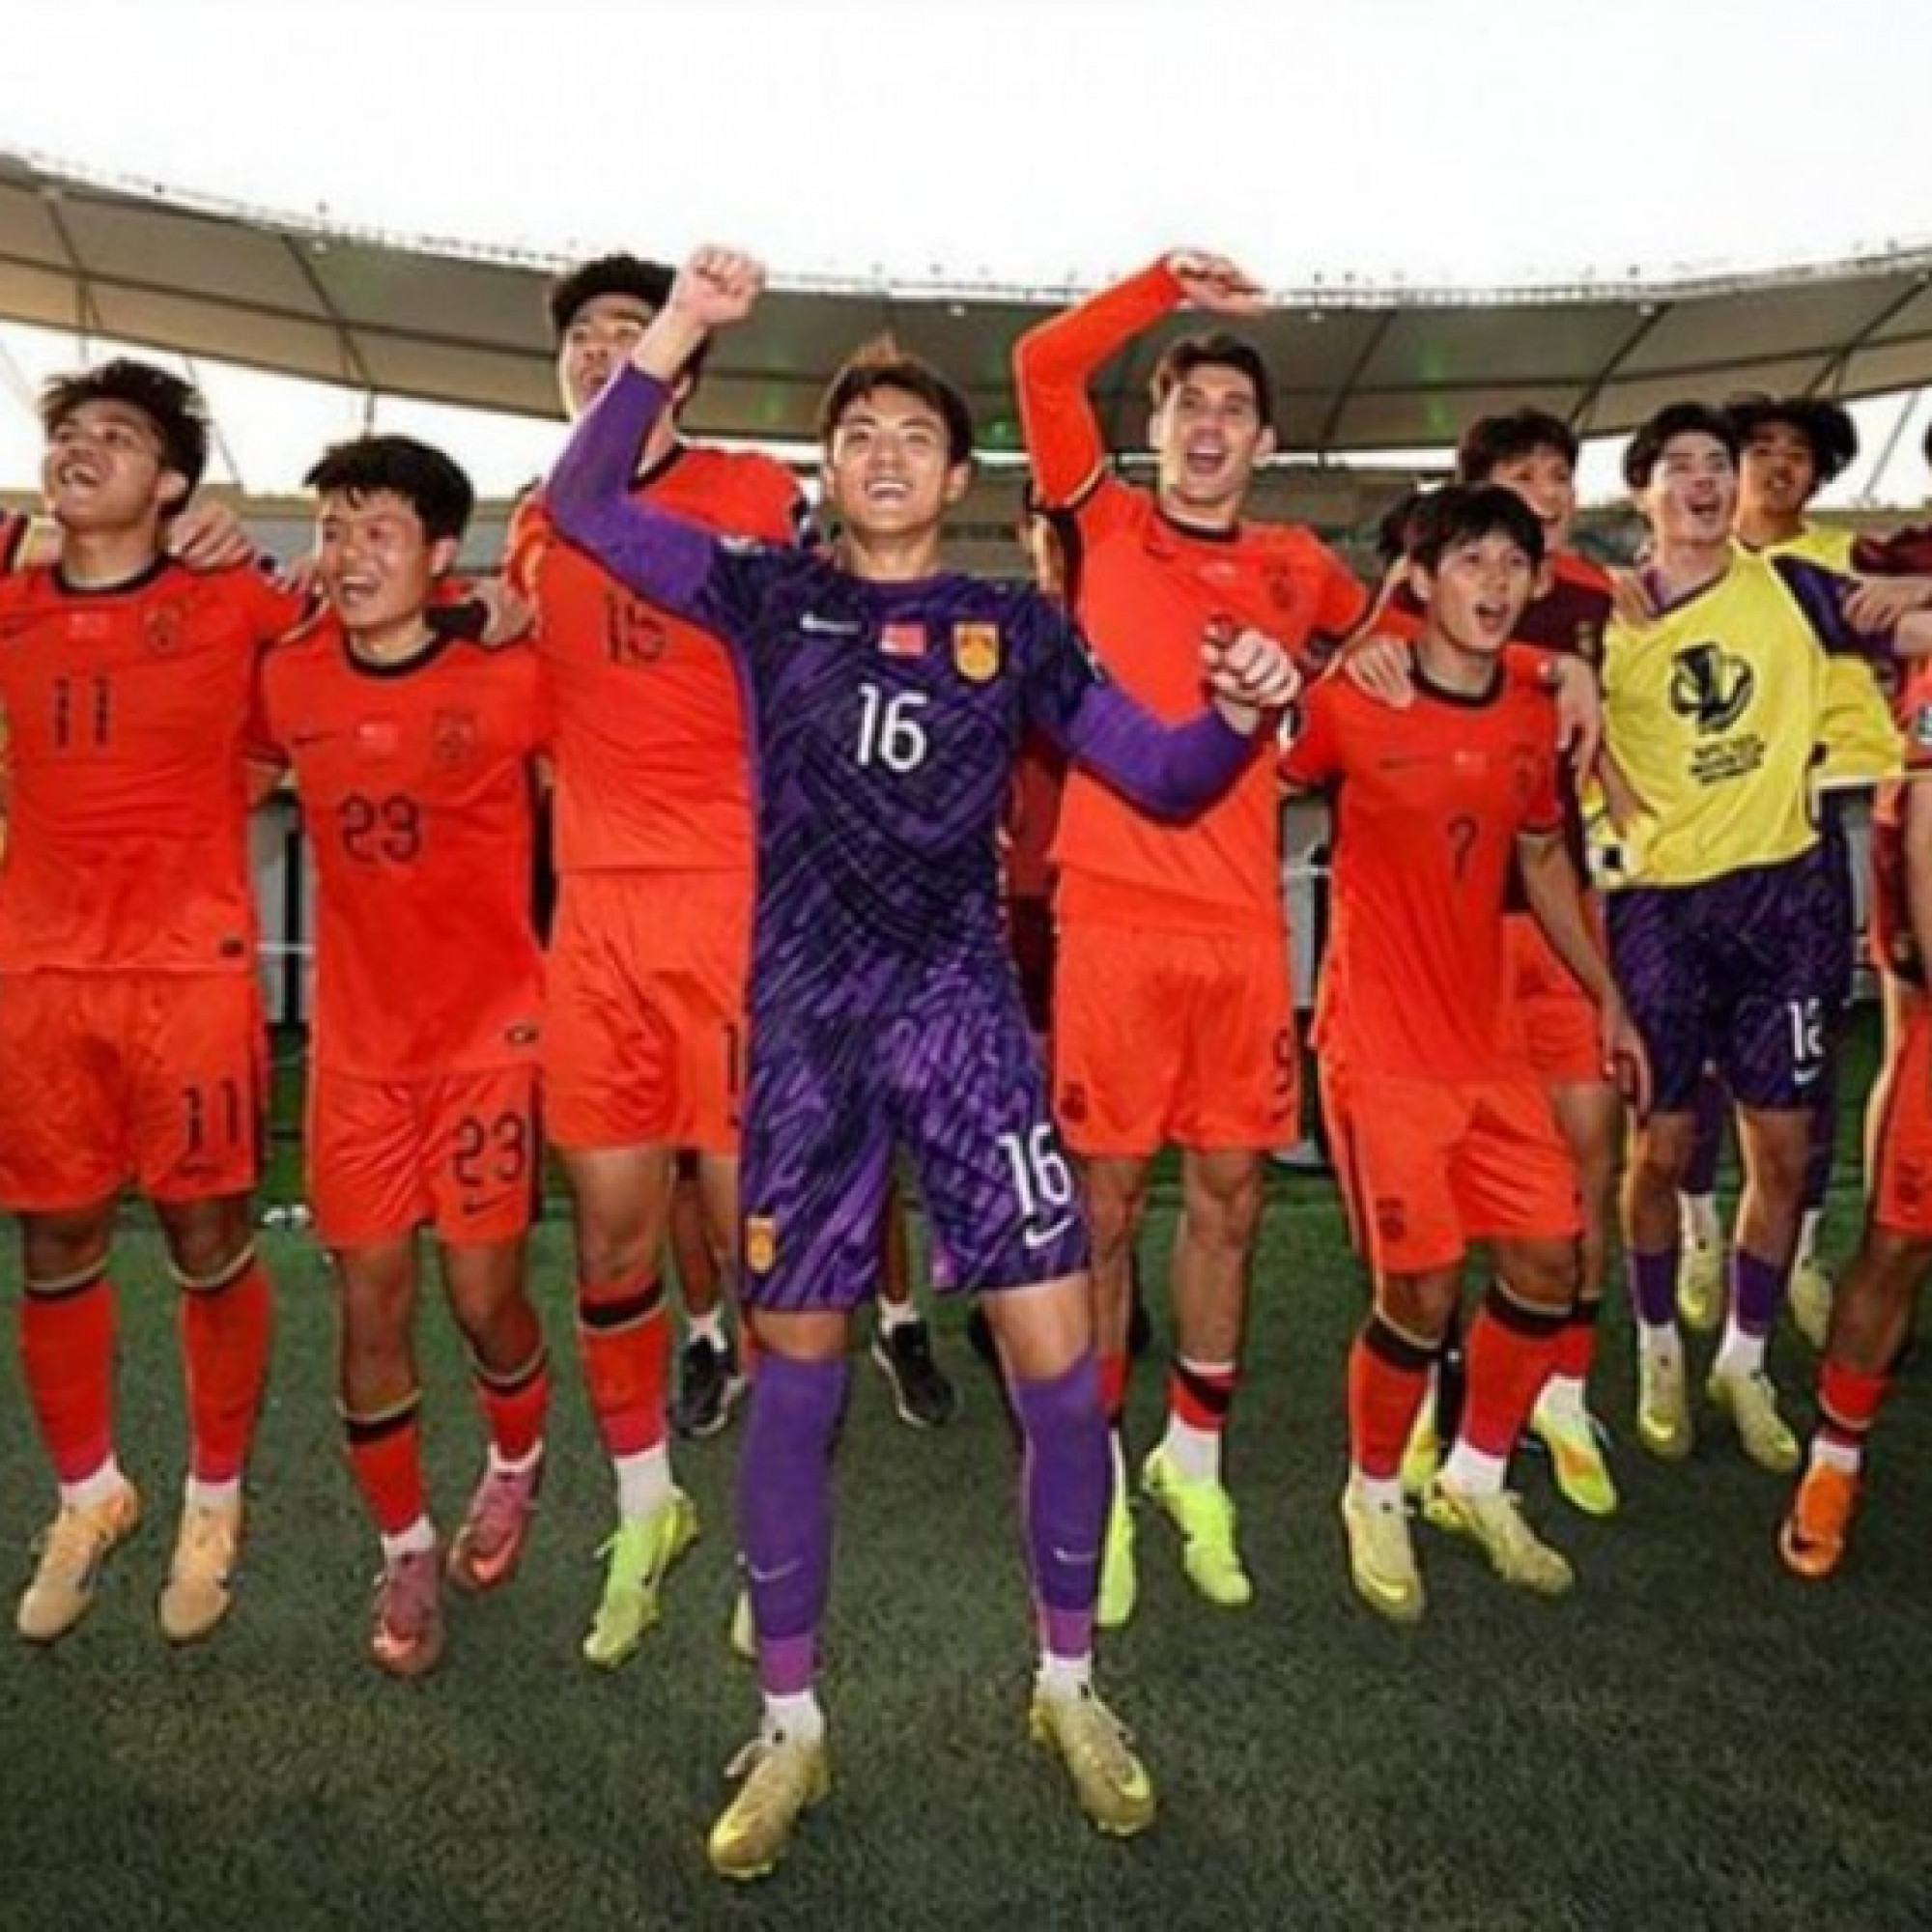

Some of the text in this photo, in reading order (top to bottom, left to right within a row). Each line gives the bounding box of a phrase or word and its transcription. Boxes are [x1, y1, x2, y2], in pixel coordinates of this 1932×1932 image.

[53, 677, 110, 748] 11
[856, 682, 929, 772] 16
[338, 792, 421, 864] 23
[180, 1076, 240, 1154] 11
[450, 1110, 527, 1189] 23
[995, 1122, 1073, 1216] 16
